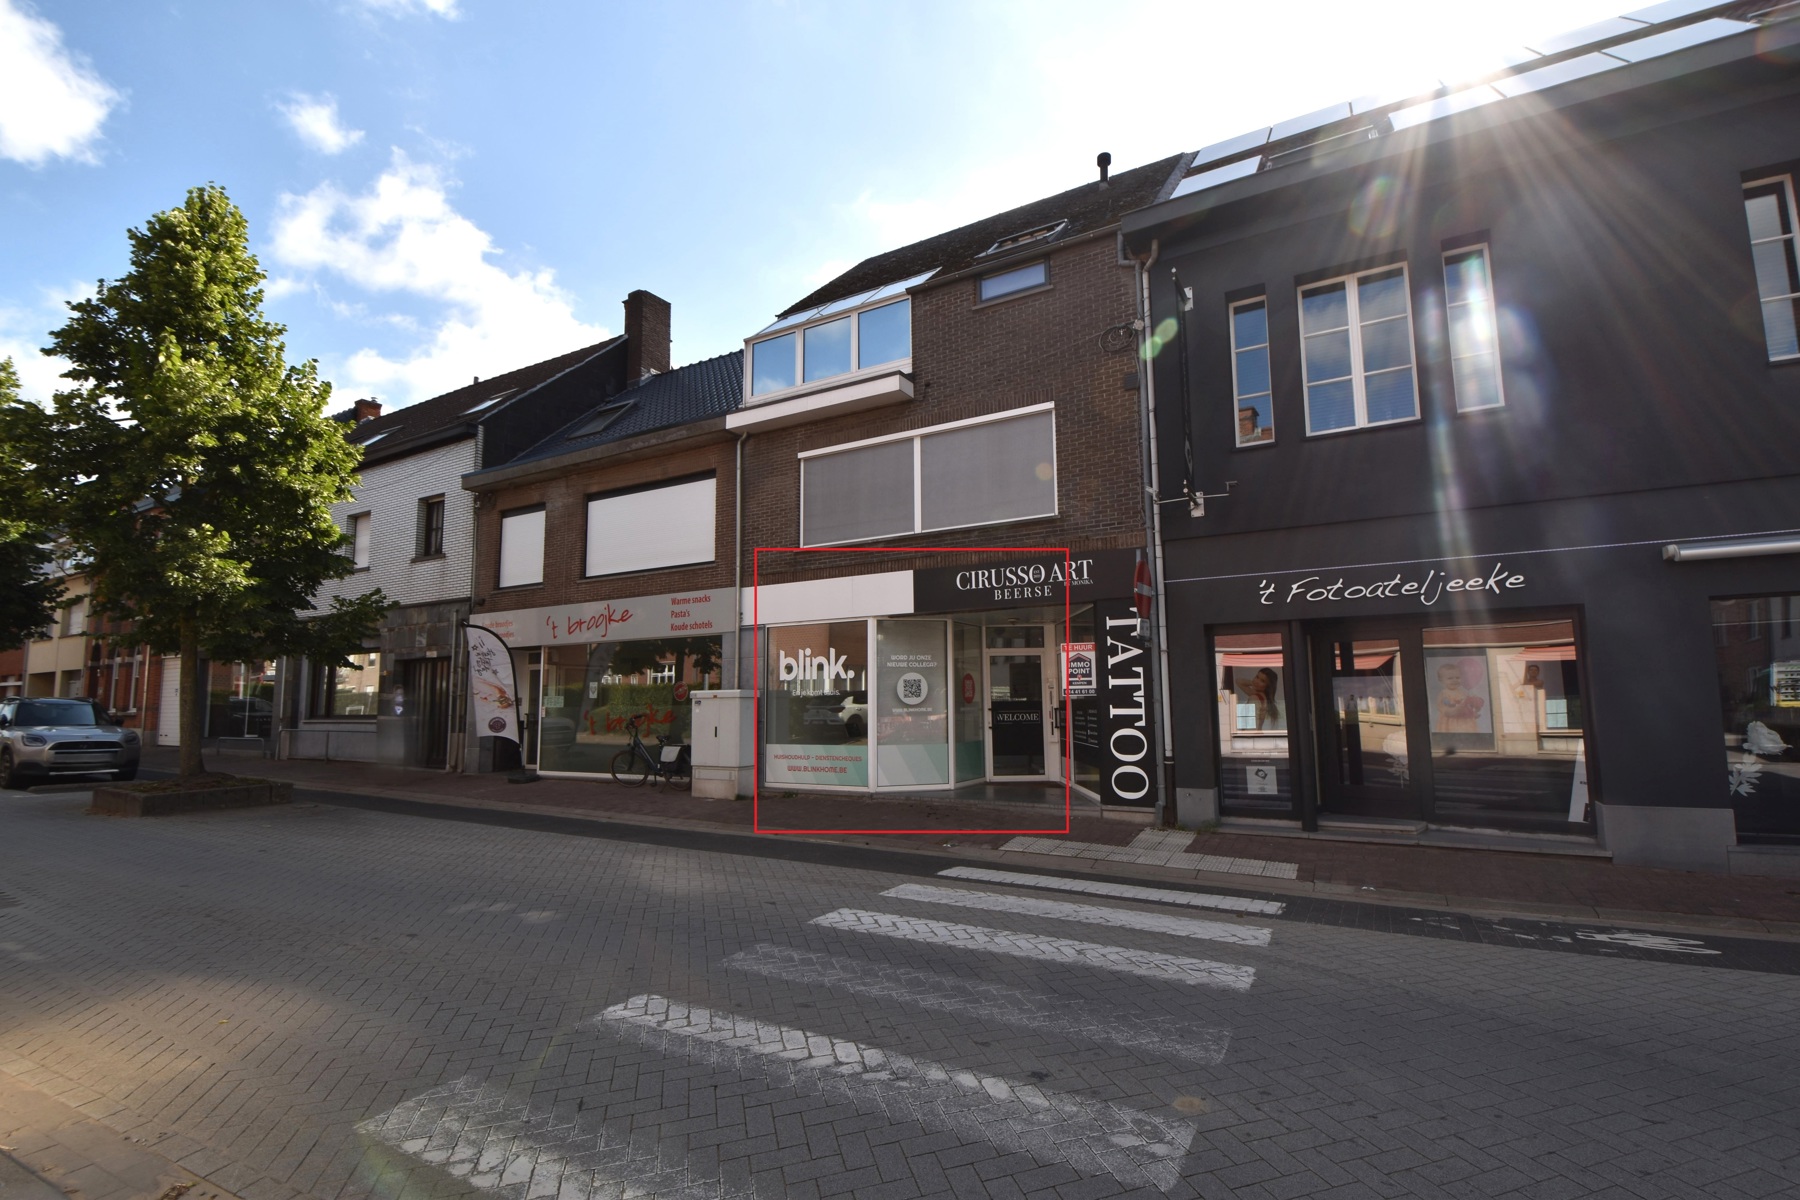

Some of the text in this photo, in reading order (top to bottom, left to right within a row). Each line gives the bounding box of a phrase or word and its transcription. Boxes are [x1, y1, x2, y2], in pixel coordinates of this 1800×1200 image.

[956, 559, 1093, 590] CIRUSSO ART
[1259, 563, 1526, 605] 't Fotoateljeeke
[671, 594, 711, 606] Warme snacks
[994, 585, 1052, 601] BEERSE
[671, 609, 690, 619] Pasta's
[546, 615, 558, 639] 't
[671, 620, 713, 631] Koude schotels
[1106, 607, 1149, 799] TATTOO
[996, 713, 1039, 721] WELCOME
